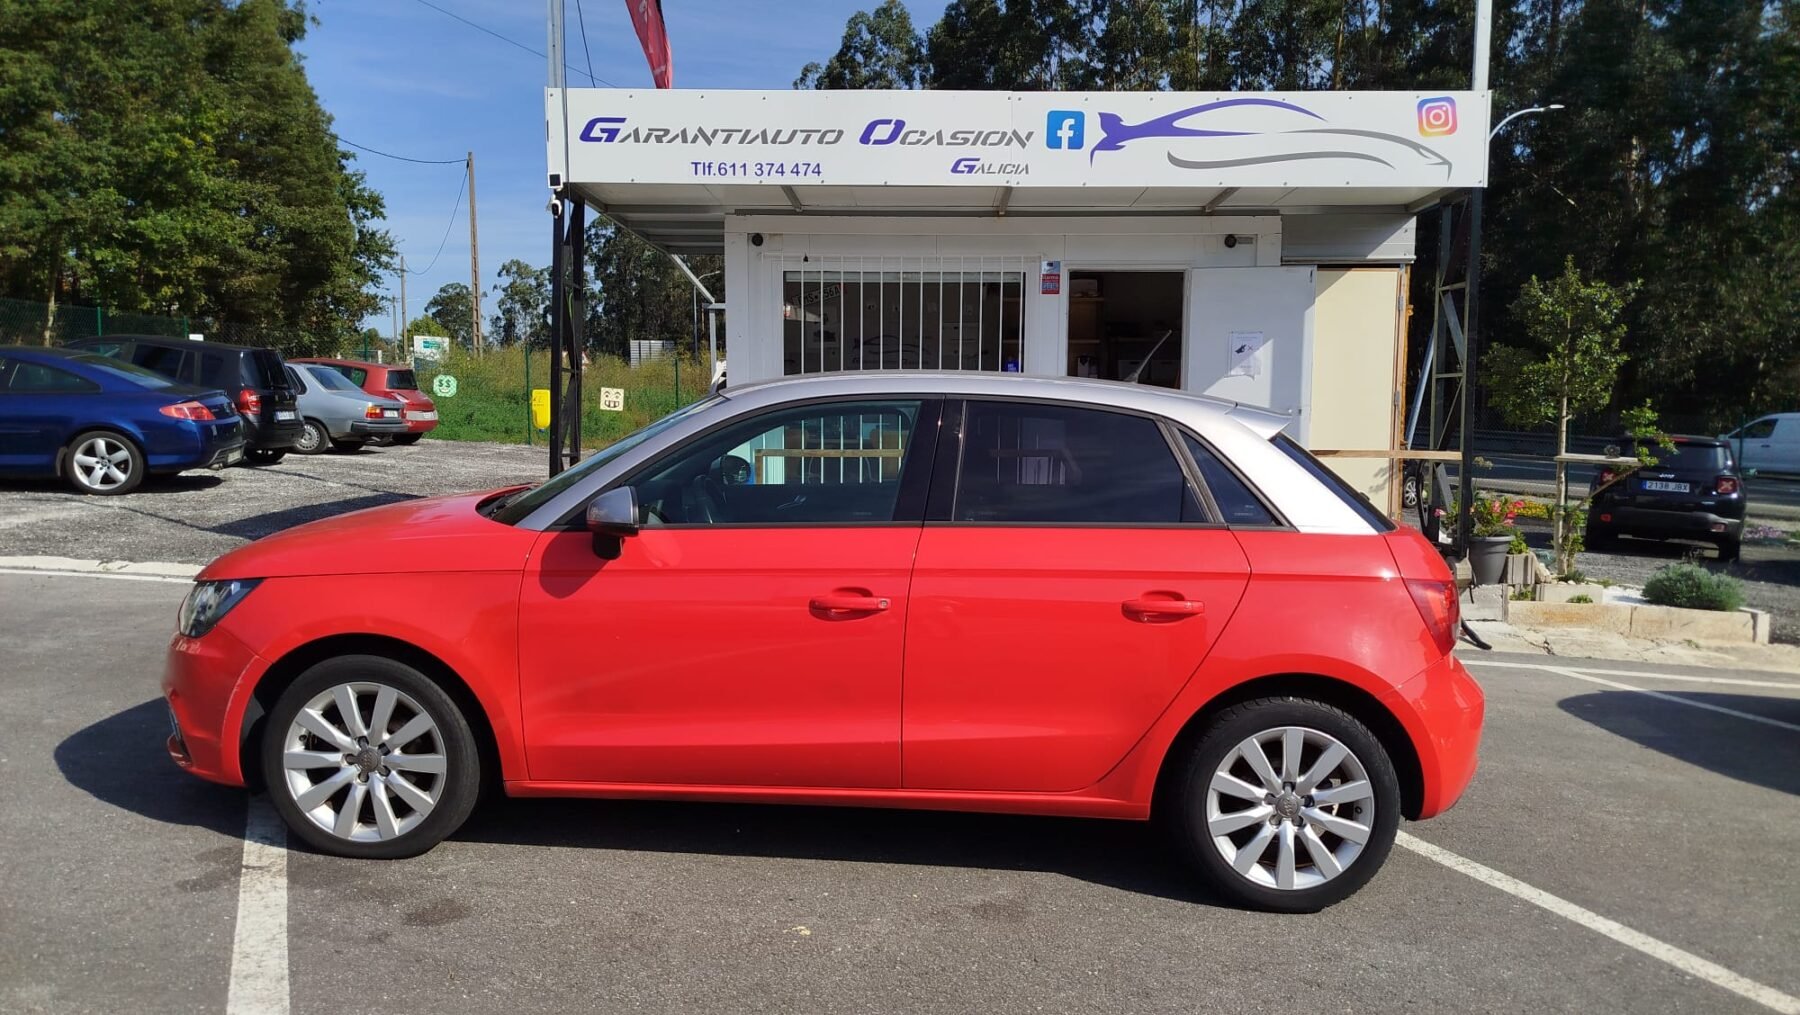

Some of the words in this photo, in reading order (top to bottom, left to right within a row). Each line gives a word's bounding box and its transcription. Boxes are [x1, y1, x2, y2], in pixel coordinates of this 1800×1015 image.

[579, 116, 844, 147] GARANTIAUTO
[859, 119, 1035, 149] OCASION
[754, 162, 785, 177] 374
[790, 162, 822, 177] 474
[950, 157, 1029, 174] GALICIA
